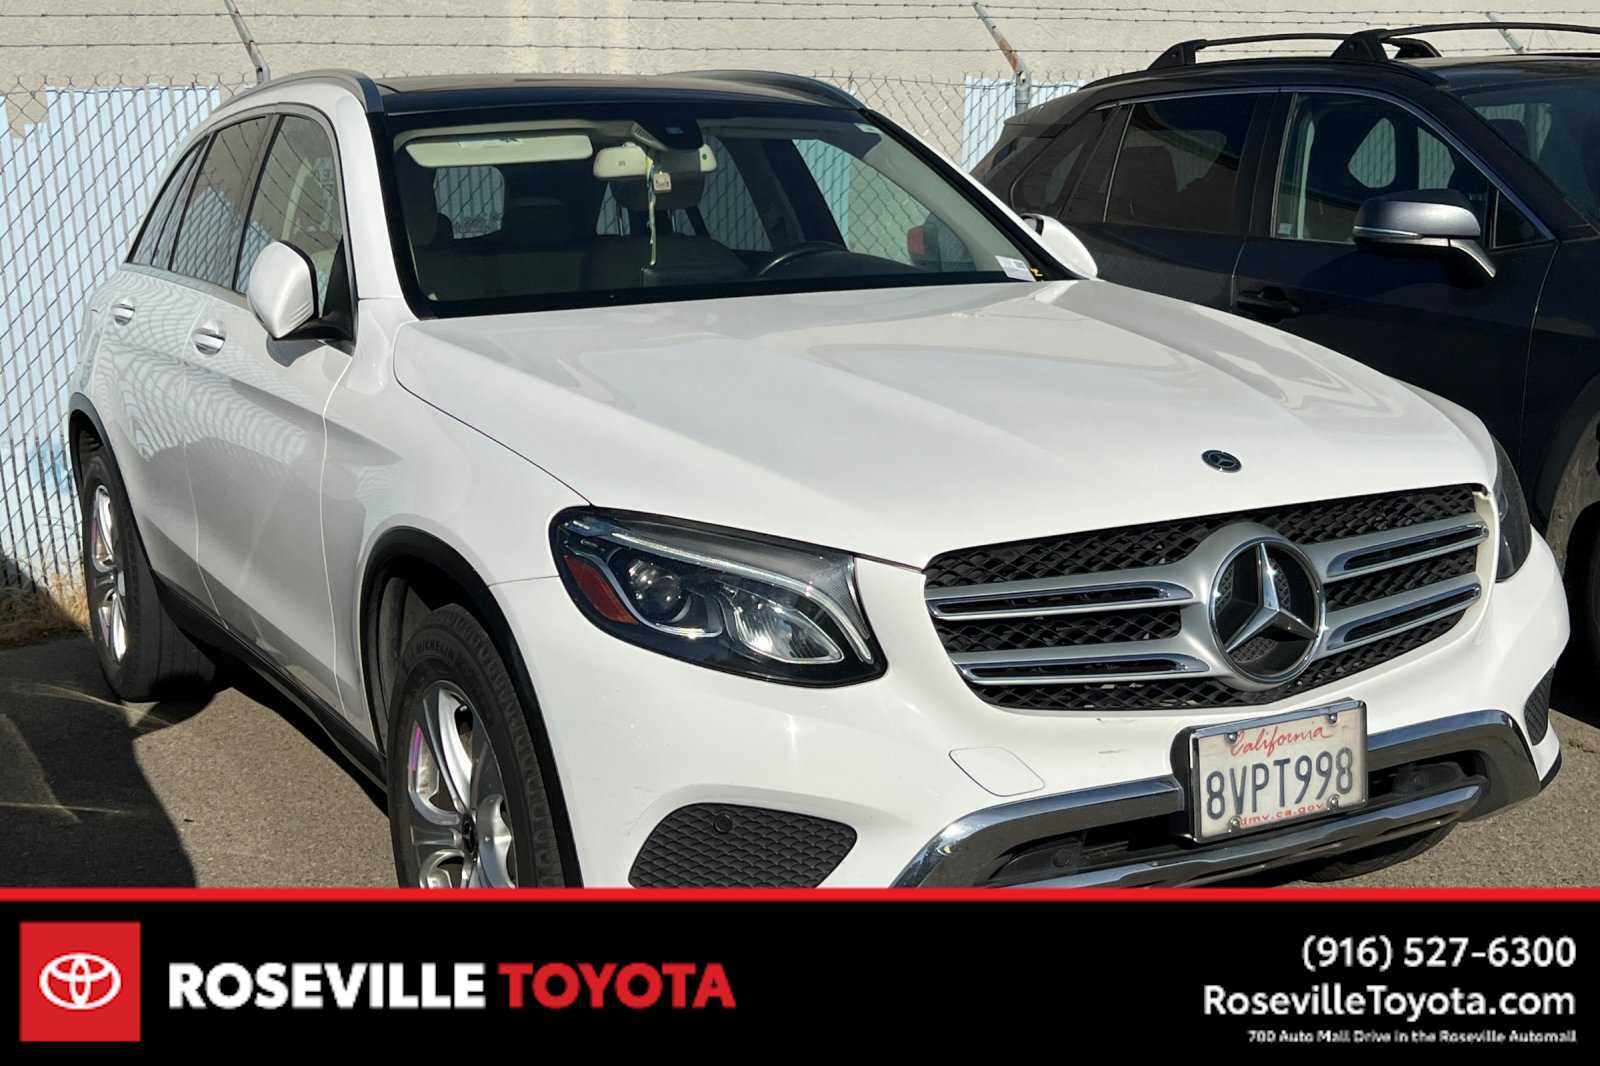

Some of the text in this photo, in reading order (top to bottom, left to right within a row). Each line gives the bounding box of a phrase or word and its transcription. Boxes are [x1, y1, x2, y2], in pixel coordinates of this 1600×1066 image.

[1231, 725, 1332, 757] California
[1206, 747, 1353, 820] 8VPT998
[1240, 802, 1323, 827] dmv.ca.gov
